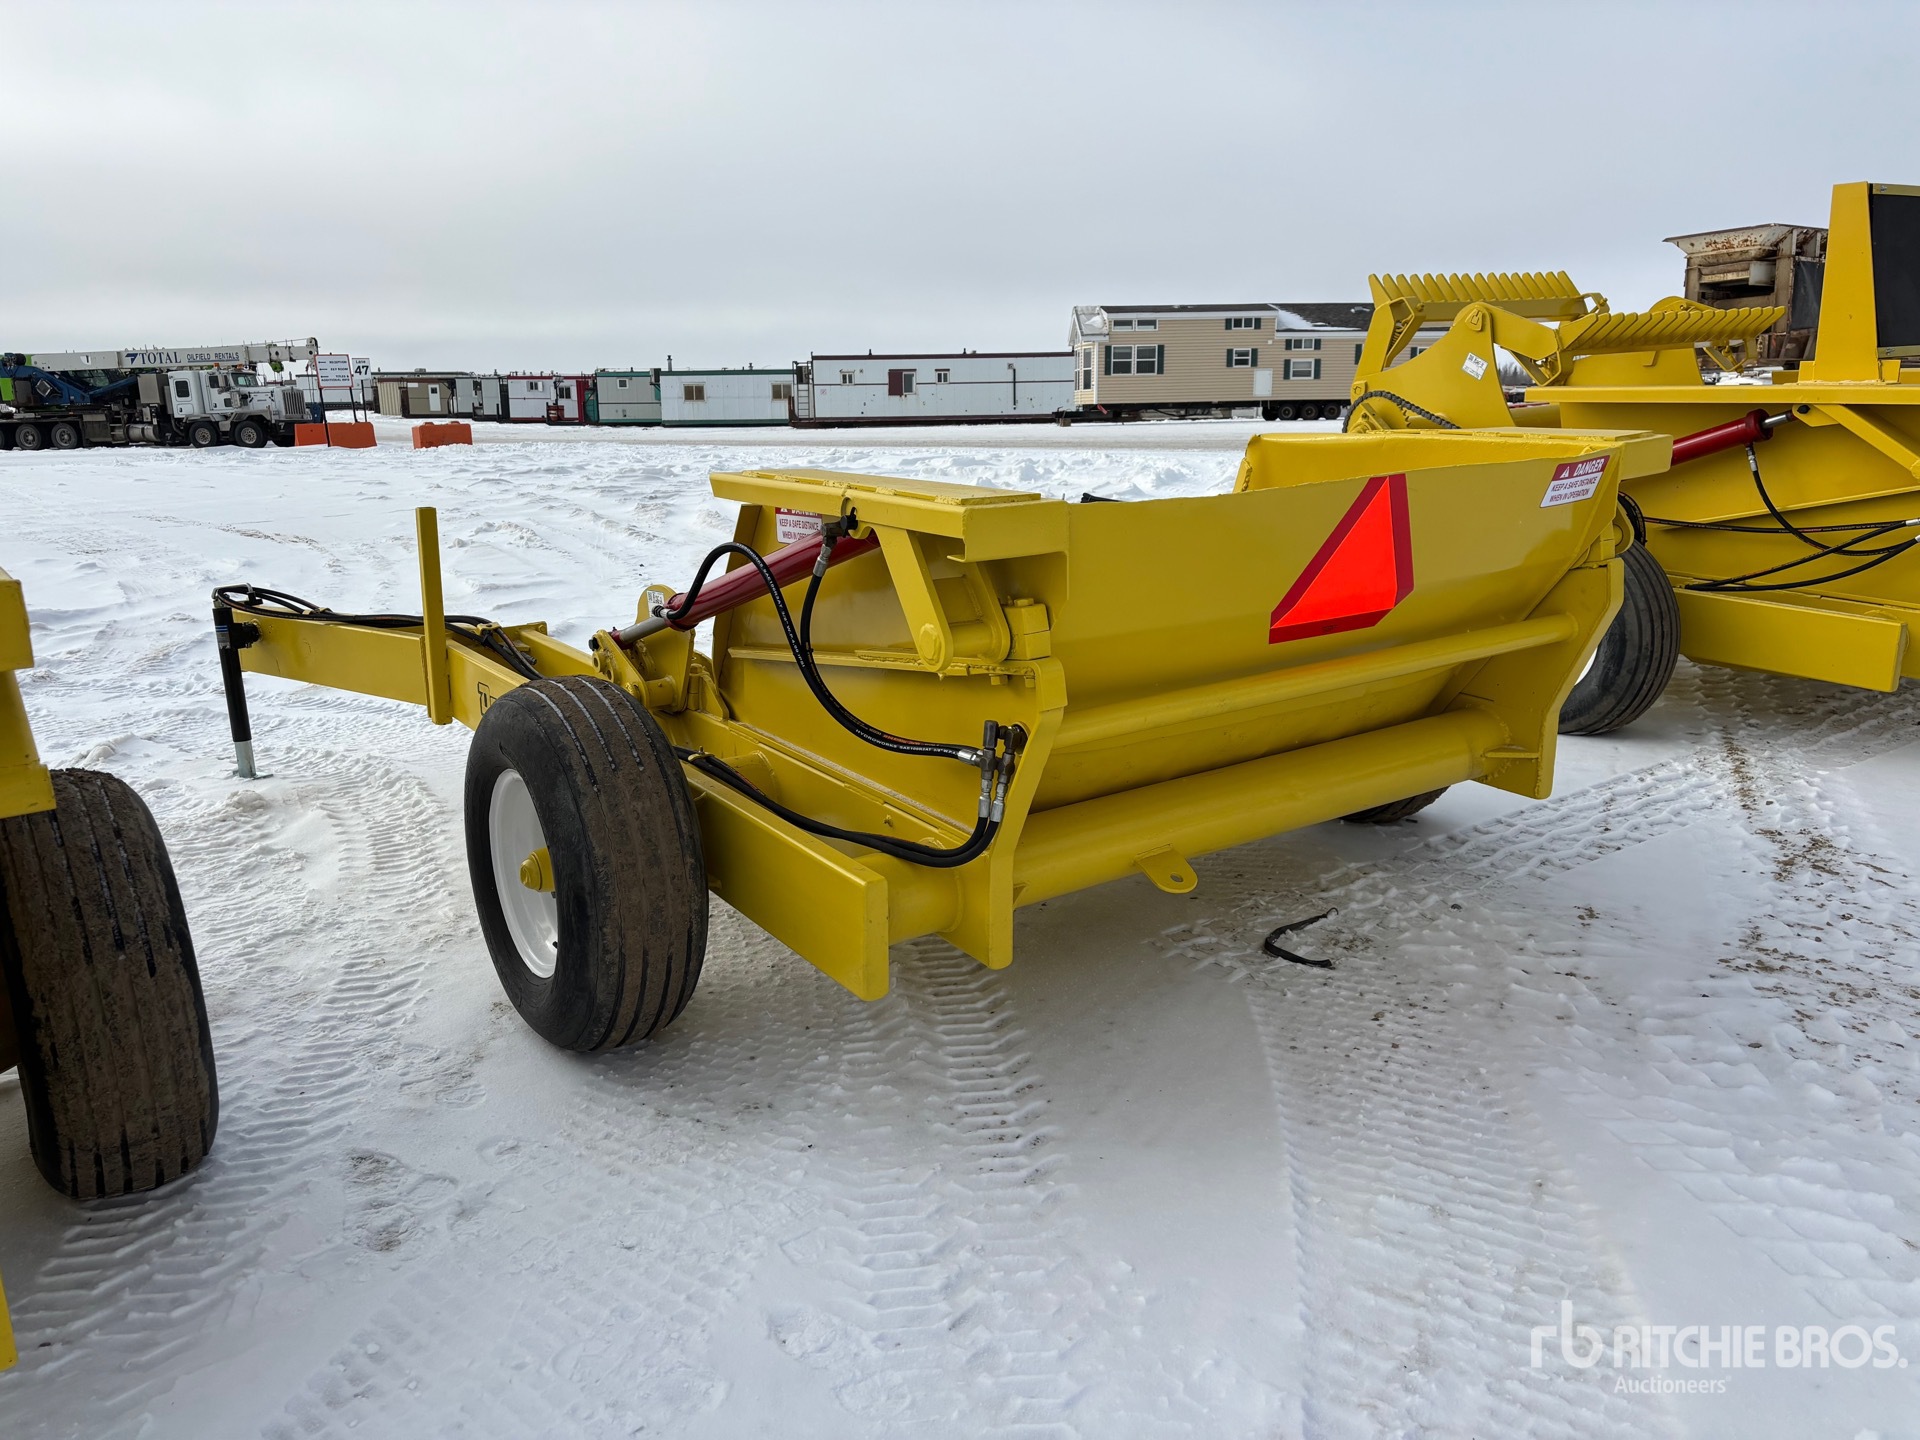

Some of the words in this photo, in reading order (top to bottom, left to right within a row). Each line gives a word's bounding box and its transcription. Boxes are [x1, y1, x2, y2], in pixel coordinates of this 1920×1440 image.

[139, 352, 181, 364] TOTAL
[186, 353, 211, 361] OILFIELD
[214, 352, 240, 360] RENTALS
[354, 365, 369, 375] 47
[1573, 458, 1605, 477] DANGER
[1551, 483, 1565, 492] KEEP
[1567, 480, 1580, 490] SAFE
[1578, 476, 1598, 488] DISTANCE
[1549, 493, 1563, 502] WHEN
[1567, 488, 1591, 499] OPERATION
[779, 518, 788, 527] KEEP
[792, 519, 801, 529] SAFE
[801, 520, 819, 531] DISTANCE
[782, 530, 792, 540] WHEN
[855, 728, 897, 749] HYDROWORKS
